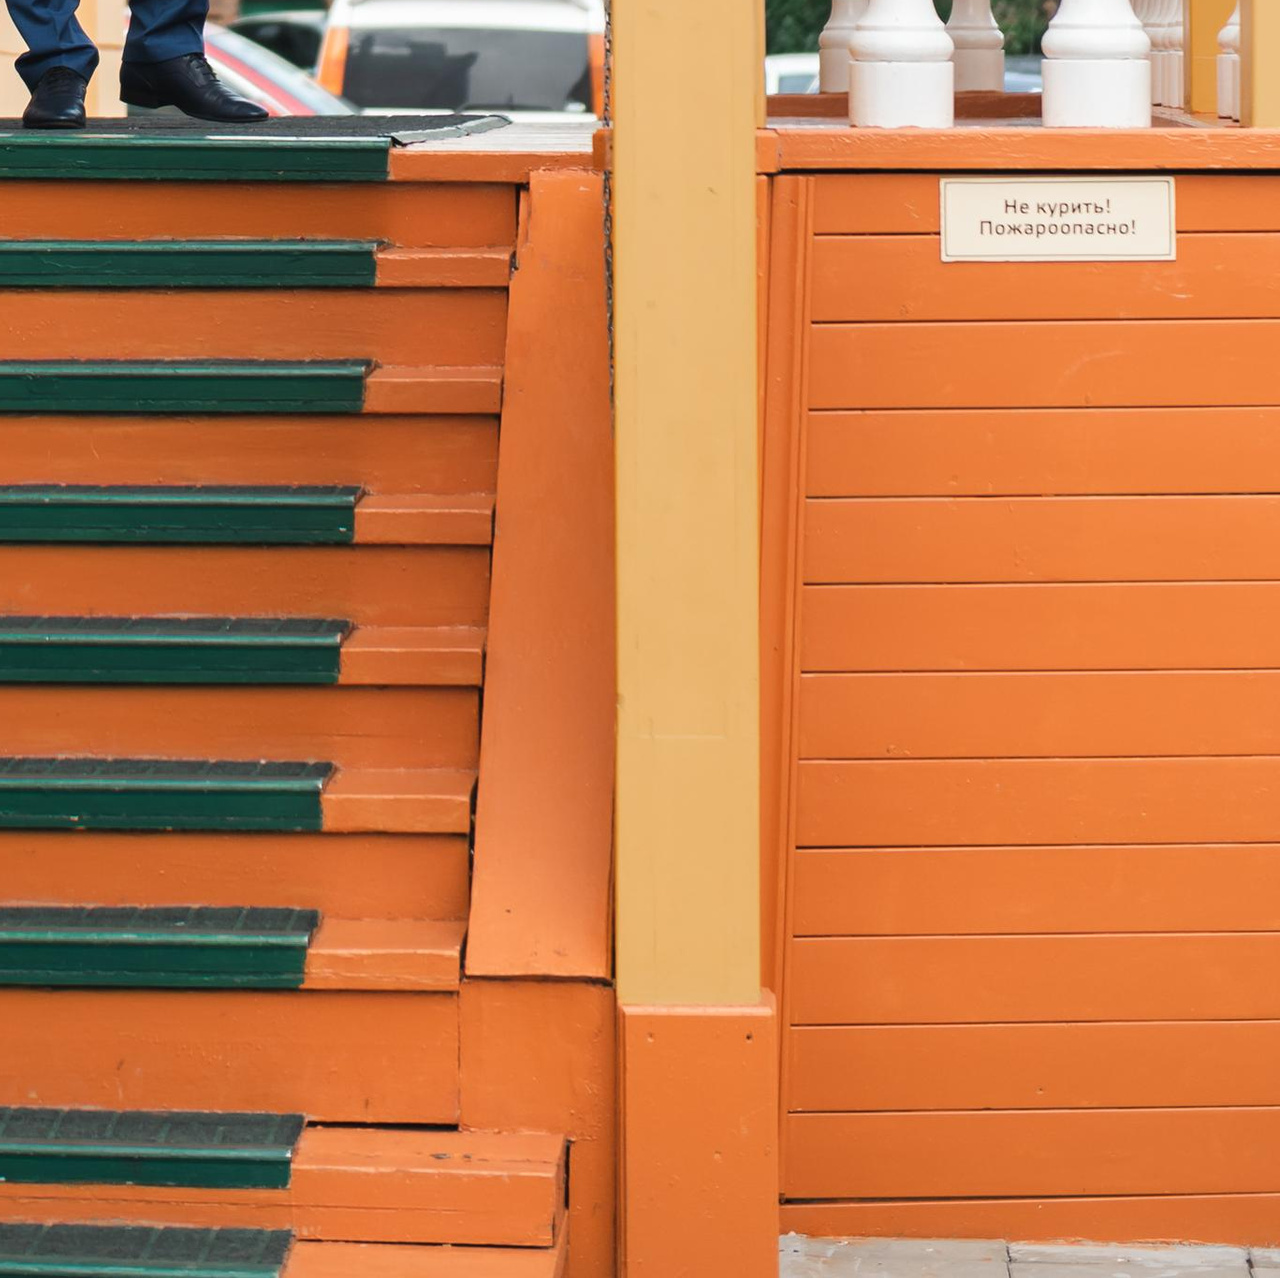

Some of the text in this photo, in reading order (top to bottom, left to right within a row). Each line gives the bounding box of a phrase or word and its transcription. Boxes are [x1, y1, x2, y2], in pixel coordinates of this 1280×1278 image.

[1004, 198, 1110, 217] Не курить!
[980, 219, 1135, 238] Пожароопасно!
